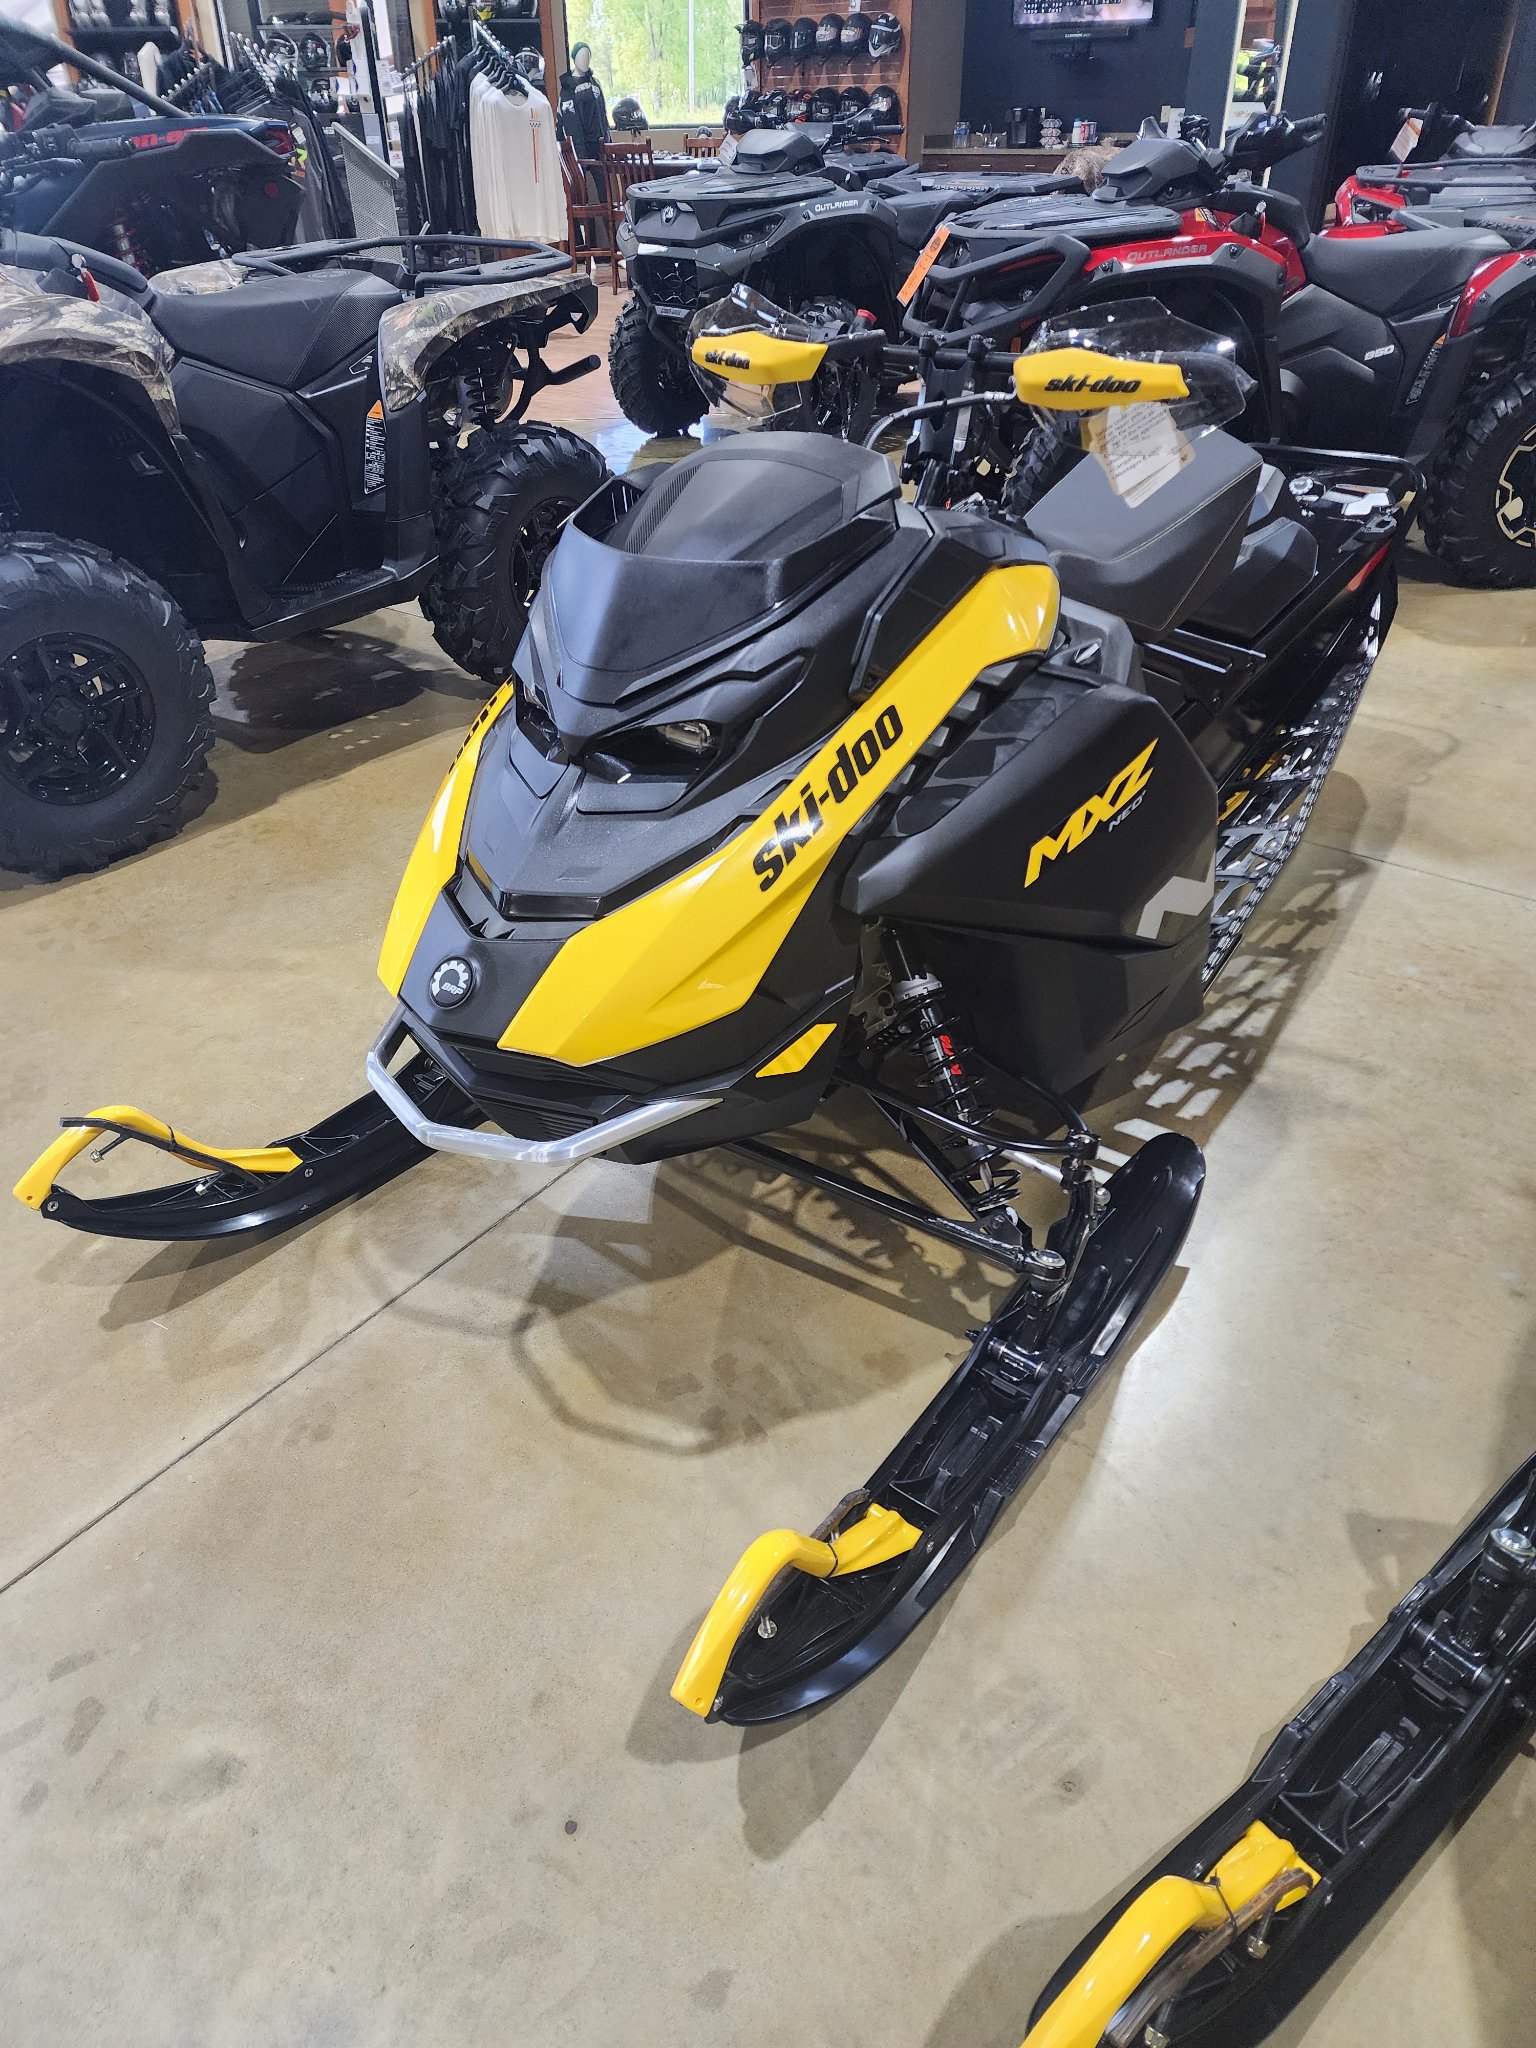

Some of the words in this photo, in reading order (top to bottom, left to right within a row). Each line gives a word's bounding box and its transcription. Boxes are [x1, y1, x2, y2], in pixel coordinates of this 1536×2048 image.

[814, 199, 859, 212] OUTLANDER
[1126, 244, 1208, 262] OUTLANDER
[704, 349, 751, 370] ski-doo
[1043, 374, 1142, 394] ski-doo
[752, 704, 904, 892] ski-doo
[1024, 737, 1160, 889] MXZ
[440, 982, 464, 995] BRP
